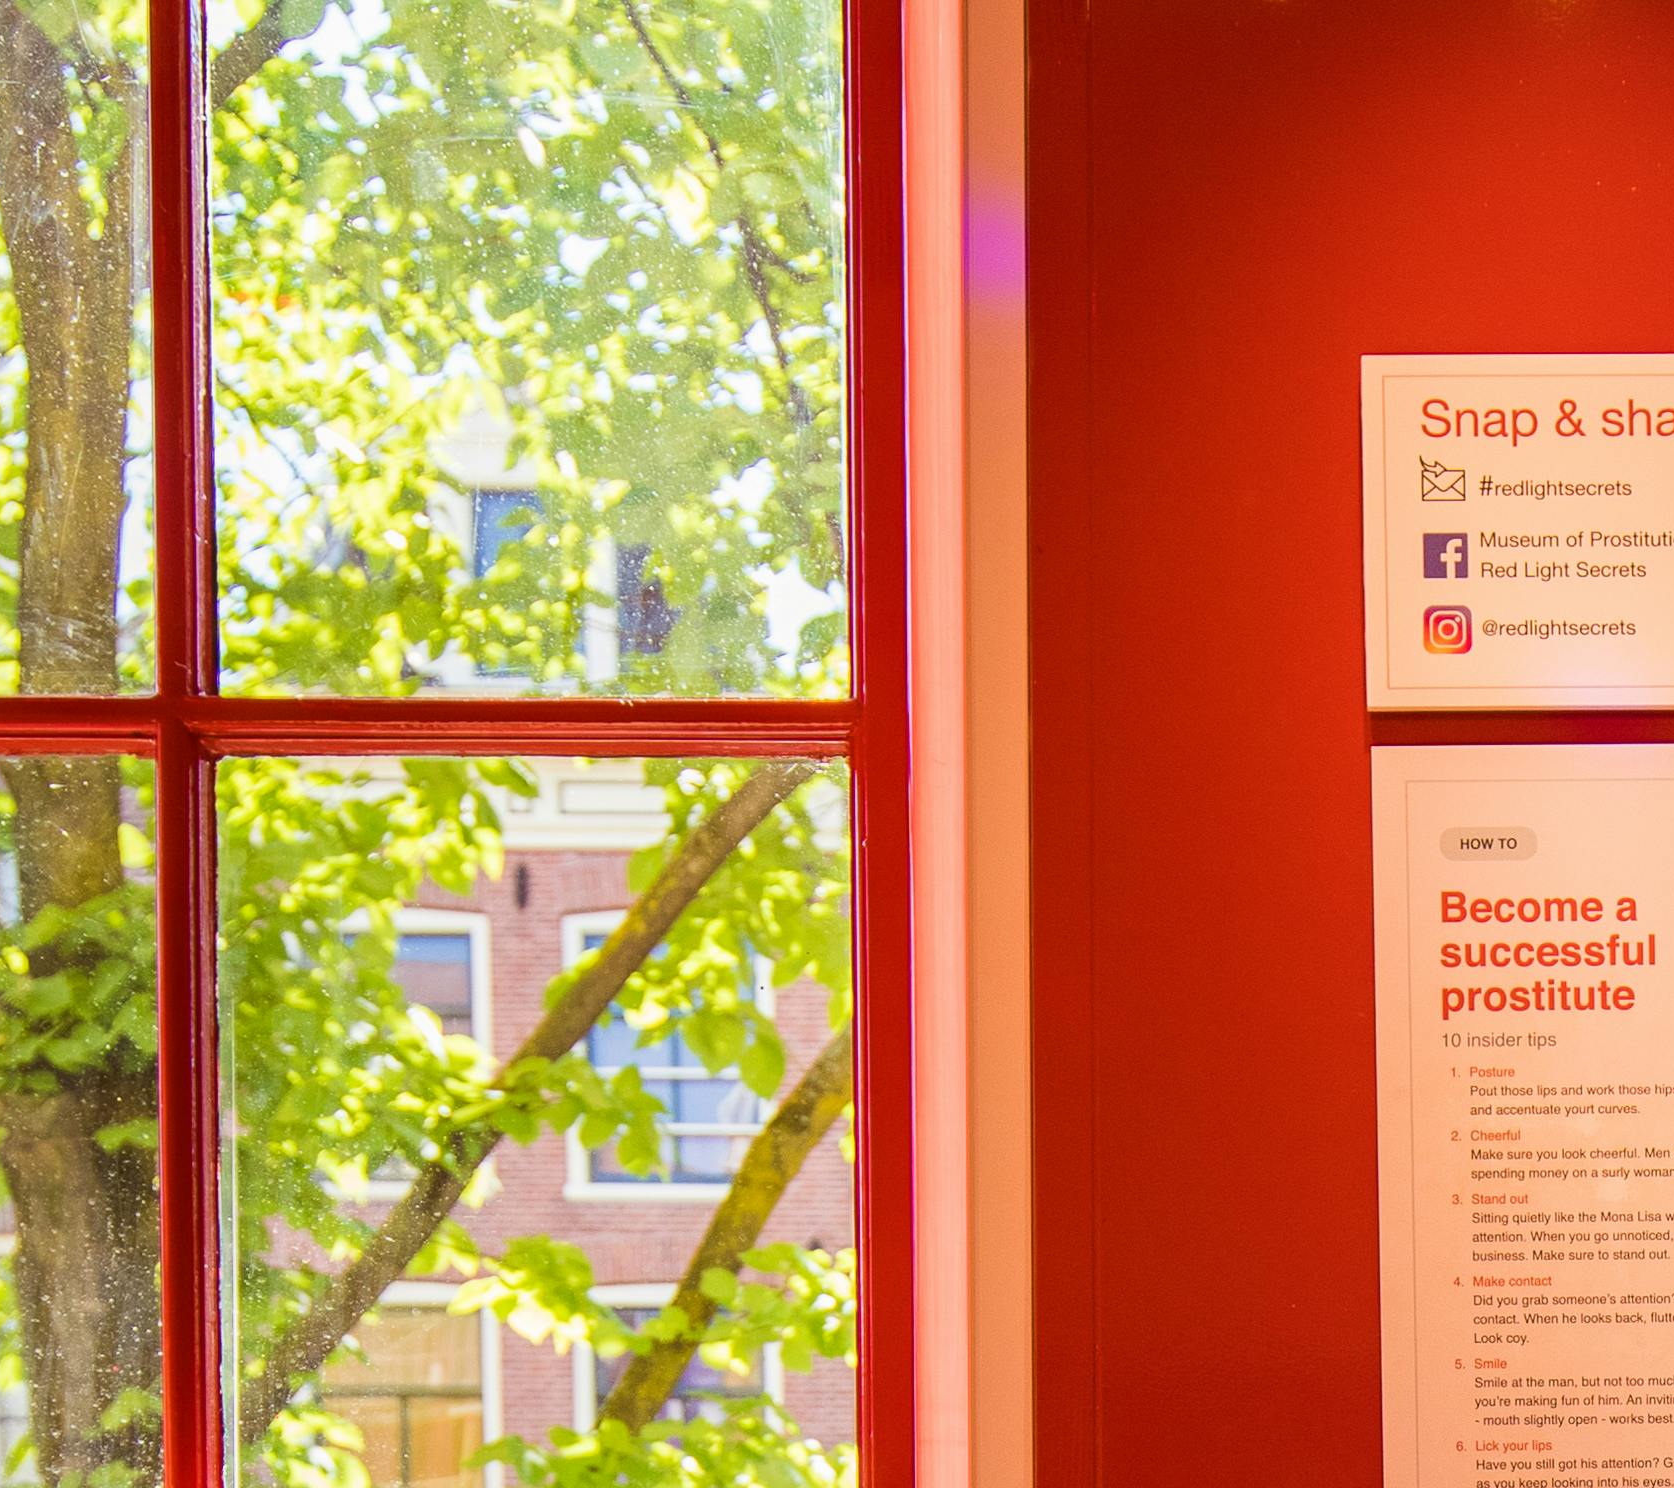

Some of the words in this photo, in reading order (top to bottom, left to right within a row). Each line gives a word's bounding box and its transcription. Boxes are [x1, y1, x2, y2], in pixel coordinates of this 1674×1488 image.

[1421, 398, 1538, 448] Snap
[1554, 398, 1587, 437] &
[1478, 474, 1632, 501] #redlightsecrets
[1480, 531, 1560, 548] Museum
[1565, 530, 1584, 548] of
[1480, 561, 1518, 579] Red
[1524, 561, 1570, 582] Light
[1576, 560, 1647, 578] Secrets
[1481, 619, 1637, 640] @redlightsecrets
[1460, 837, 1495, 850] HOW
[1497, 837, 1518, 850] TO
[1440, 890, 1604, 924] Become
[1615, 896, 1638, 923] a
[1439, 933, 1656, 968] successful
[1441, 978, 1636, 1021] prostitute
[1442, 1032, 1462, 1048] 10
[1467, 1031, 1523, 1048] insider
[1527, 1031, 1557, 1051] tips
[1451, 1066, 1461, 1078] 1.
[1469, 1066, 1516, 1078] Posture
[1469, 1085, 1498, 1097] Pout
[1500, 1084, 1534, 1097] those
[1536, 1084, 1558, 1099] lips
[1560, 1084, 1583, 1096] and
[1586, 1084, 1615, 1096] work
[1618, 1084, 1651, 1096] those
[1469, 1103, 1493, 1116] and
[1495, 1104, 1562, 1116] accentuate
[1597, 1105, 1640, 1115] curves.
[1450, 1129, 1462, 1142] 2.
[1470, 1129, 1521, 1142] Cheerful
[1470, 1148, 1504, 1161] Make
[1506, 1150, 1533, 1160] sure
[1536, 1150, 1558, 1162] you
[1561, 1147, 1587, 1160] look
[1589, 1147, 1640, 1160] cheerful.
[1644, 1147, 1671, 1159] Men
[1470, 1167, 1526, 1182] spending
[1528, 1168, 1569, 1182] money
[1572, 1168, 1588, 1178] on
[1590, 1169, 1599, 1179] a
[1601, 1166, 1631, 1181] surly
[1451, 1193, 1463, 1205] 3.
[1471, 1192, 1507, 1205] Stand
[1509, 1194, 1529, 1205] out
[1453, 1276, 1464, 1287] 4.
[1472, 1275, 1506, 1288] Make
[1508, 1275, 1552, 1288] contact
[1454, 1358, 1466, 1370] 5.
[1474, 1357, 1508, 1370] Smile
[1455, 1440, 1467, 1453] 6.
[1475, 1439, 1500, 1452] Lick
[1502, 1441, 1529, 1454] your
[1531, 1439, 1553, 1454] lips
[1476, 1459, 1507, 1471] Have
[1510, 1460, 1532, 1473] you
[1535, 1458, 1555, 1470] still
[1557, 1459, 1577, 1473] got
[1580, 1457, 1598, 1470] his
[1601, 1456, 1660, 1469] attention?
[1597, 1476, 1619, 1488] into
[1621, 1476, 1640, 1488] his
